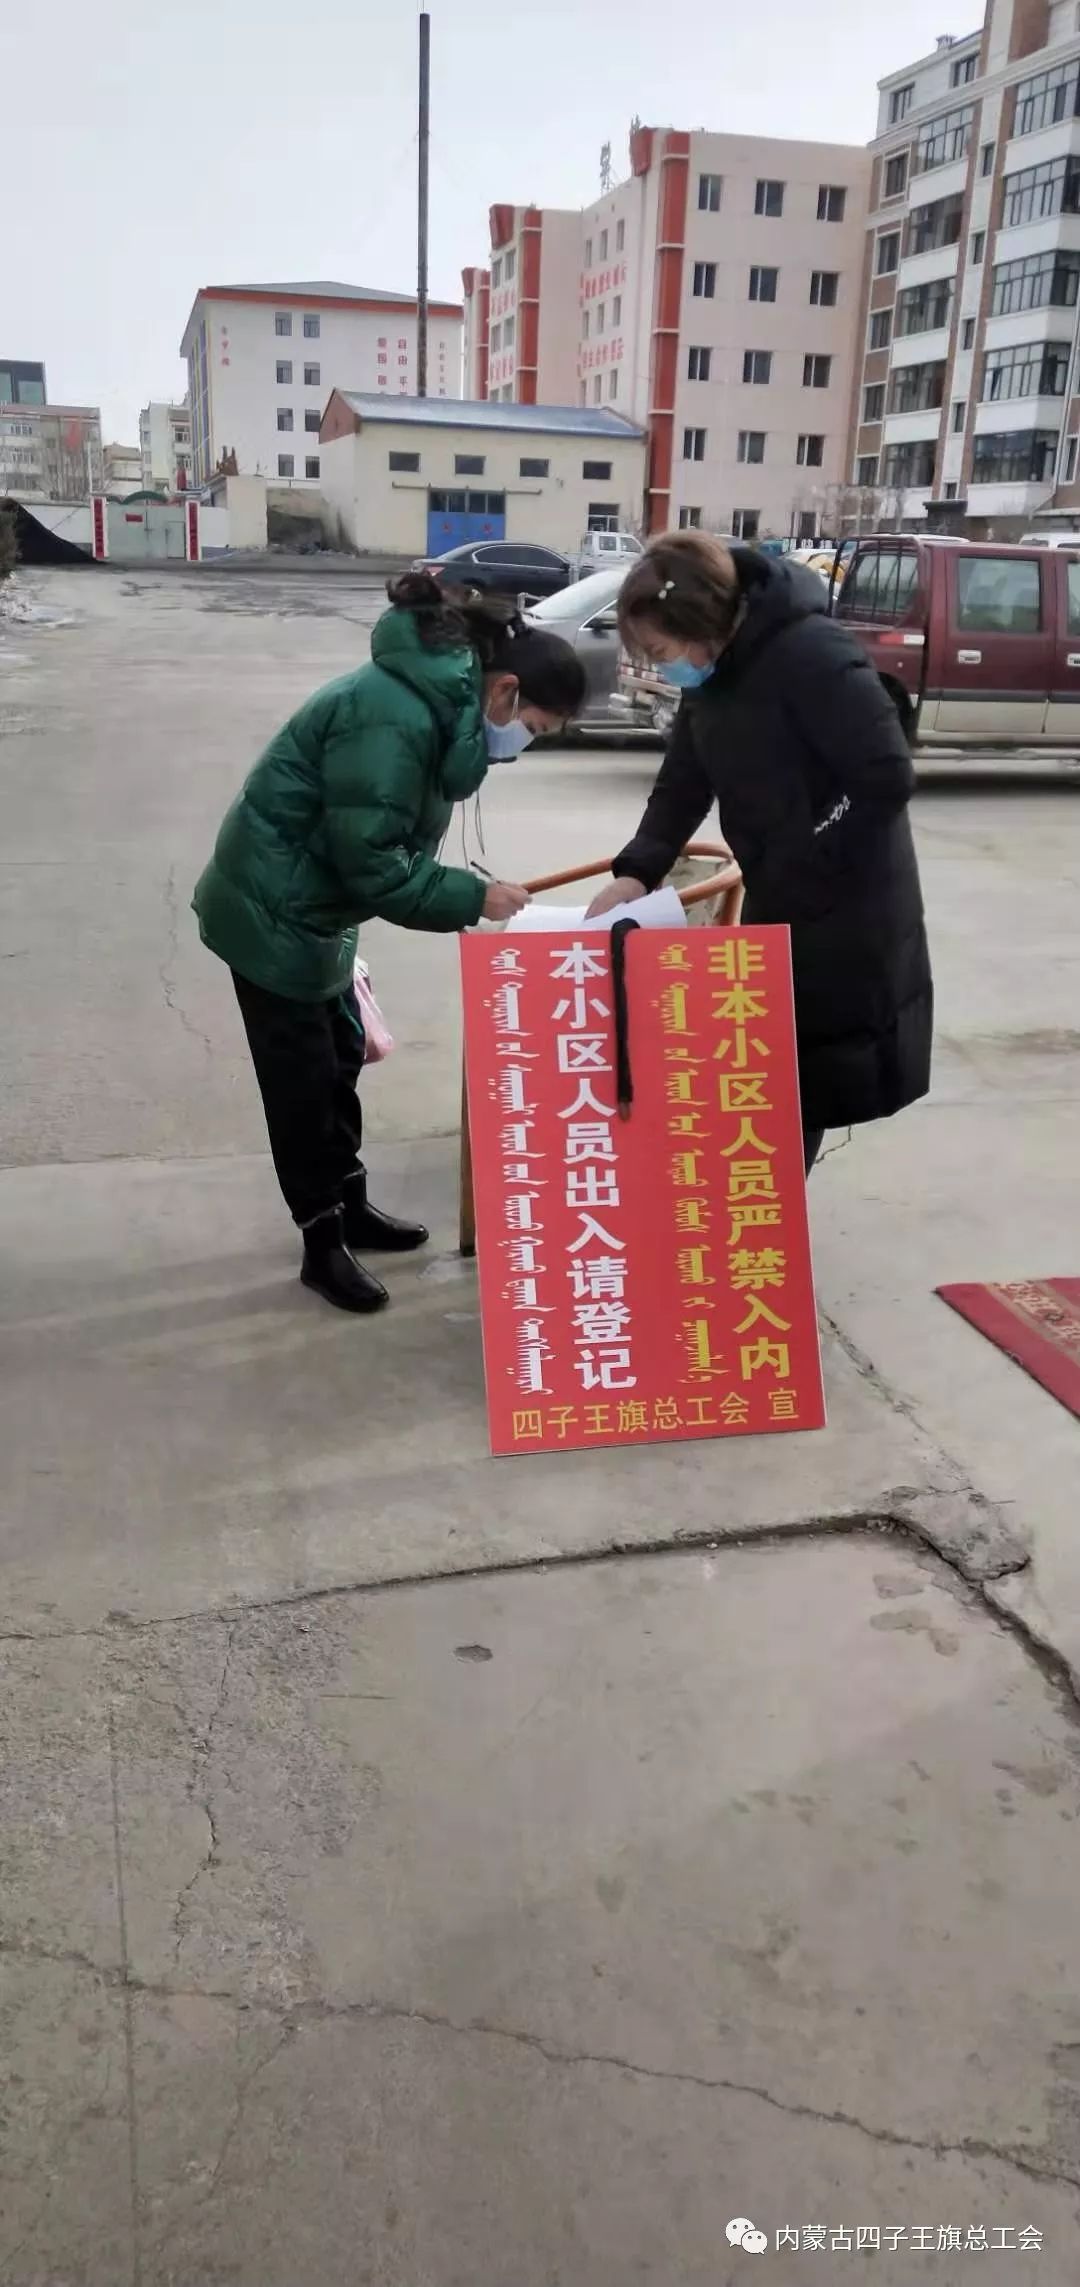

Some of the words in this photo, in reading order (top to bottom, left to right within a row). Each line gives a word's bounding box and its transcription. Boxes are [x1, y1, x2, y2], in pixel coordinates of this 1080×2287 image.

[549, 942, 637, 1390] 本小区人员出入请登记
[707, 939, 791, 1380] 非本小区人员严禁入内
[512, 1392, 750, 1440] 四子王旗总工会
[768, 1388, 799, 1421] 宣
